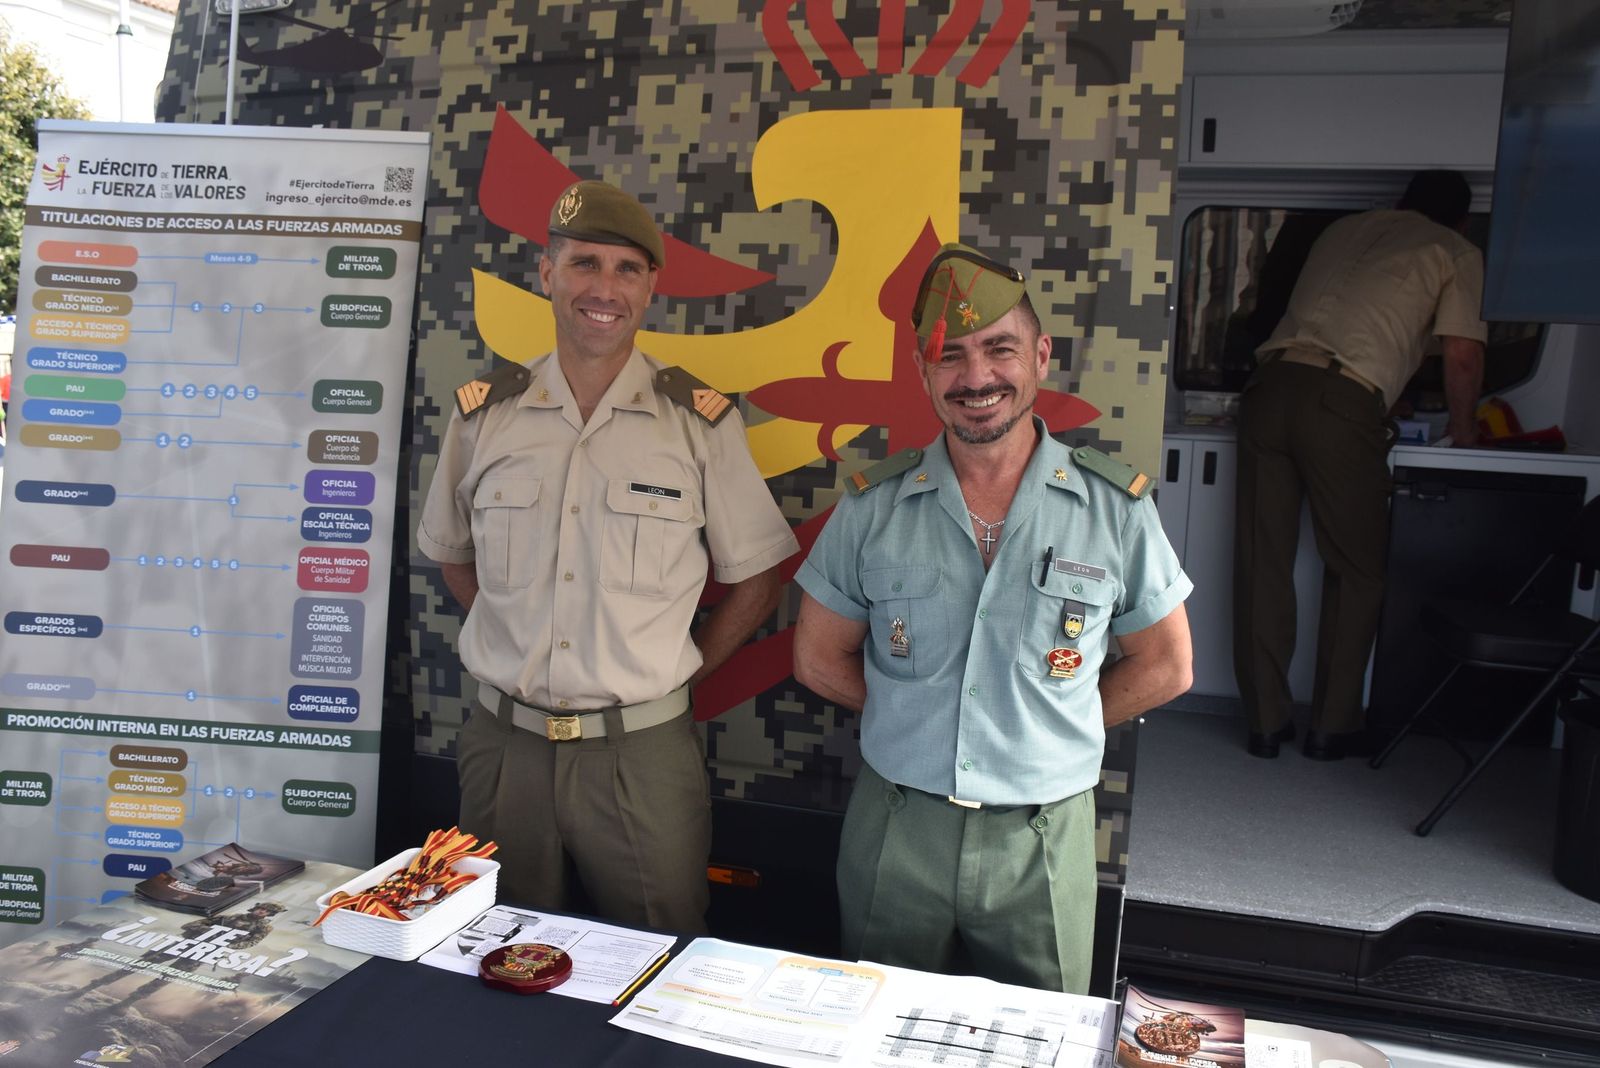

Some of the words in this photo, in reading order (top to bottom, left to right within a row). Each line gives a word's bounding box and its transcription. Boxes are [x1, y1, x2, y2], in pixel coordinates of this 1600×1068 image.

[79, 158, 157, 178] EJÉRCITO
[289, 180, 375, 190] #EjercitodeTierra
[92, 181, 156, 198] FUERZA
[174, 184, 246, 200] VALORES
[265, 192, 412, 207] ingreso_ejercito@mde.es
[41, 211, 143, 228] TITULACIONES
[146, 217, 164, 228] DE
[167, 218, 222, 230] ACCESO
[225, 219, 235, 230] A
[238, 219, 263, 231] LAS
[266, 220, 329, 233] FUERZAS
[331, 223, 403, 235] ARMADAS
[210, 254, 236, 263] Meses
[343, 255, 380, 263] MILITAR
[338, 263, 350, 271] DE
[353, 263, 383, 272] TROPA
[51, 273, 121, 286] BACHILLERATO
[62, 293, 104, 304] TÉCNICO
[45, 301, 79, 311] GRADO
[194, 303, 200, 311] 1
[329, 303, 383, 313] SUBOFICIAL
[330, 312, 353, 321] Cuerpo
[354, 312, 380, 321] General
[36, 320, 74, 328] ACCESO
[75, 321, 83, 329] A
[85, 320, 125, 332] TÉCNICO
[35, 327, 69, 337] GRADO
[56, 351, 98, 361] TÉCNICO
[31, 360, 66, 368] GRADO
[65, 384, 86, 393] PAU
[163, 386, 172, 395] 1
[185, 386, 194, 396] 2
[207, 387, 216, 397] 3
[226, 387, 235, 397] 4
[246, 388, 255, 398] 5
[329, 389, 366, 397] OFICIAL
[322, 397, 346, 406] Cuerpo
[346, 398, 372, 406] General
[159, 436, 166, 445] 1
[180, 437, 189, 447] 2
[325, 435, 361, 444] OFICIAL
[326, 444, 350, 452] Cuerpo
[323, 453, 361, 461] Intendencia
[322, 479, 358, 488] OFICIAL
[322, 488, 356, 498] Ingenieros
[647, 487, 665, 495] LEON
[230, 497, 237, 505] 1
[319, 512, 355, 520] OFICIAL
[303, 520, 334, 529] ESCALA
[335, 521, 370, 531] TÉCNICA
[318, 530, 352, 540] Ingenieros
[51, 554, 71, 562] PAU
[139, 557, 146, 565] 1
[157, 557, 164, 565] 2
[175, 558, 183, 566] 3
[193, 559, 202, 567] 4
[212, 560, 219, 568] 5
[230, 561, 238, 569] 6
[300, 556, 332, 565] OFICIAL
[334, 556, 368, 567] MÉDICO
[310, 566, 334, 575] Cuerpo
[335, 566, 356, 575] Militar
[314, 575, 323, 583] de
[324, 575, 351, 584] Sanidad
[312, 605, 345, 614] OFICIAL
[34, 616, 75, 626] GRADOS
[308, 613, 349, 623] CUERPOS
[192, 627, 199, 635] 1
[312, 634, 342, 643] SANIDAD
[310, 644, 343, 653] JURÍDICO
[301, 654, 351, 664] INTERVENCIÓN
[298, 663, 324, 673] MÚSICA
[325, 665, 352, 675] MILITAR
[188, 692, 194, 700] 1
[300, 695, 334, 704] OFICIAL
[335, 697, 348, 705] DE
[289, 703, 358, 715] COMPLEMENTO
[7, 714, 94, 731] PROMOCIÓN
[97, 719, 157, 735] INTERNA
[160, 725, 179, 737] EN
[181, 725, 208, 739] LAS
[210, 727, 275, 743] FUERZAS
[278, 731, 352, 747] ARMADAS
[118, 753, 179, 764] BACHILLERATO
[6, 779, 43, 789] MILITAR
[128, 774, 165, 784] TÉCNICO
[114, 783, 144, 792] GRADO
[206, 787, 213, 795] 1
[226, 788, 233, 797] 2
[246, 789, 254, 798] 3
[1, 788, 14, 797] DE
[15, 789, 47, 799] TROPA
[284, 788, 353, 800] SUBOFICIAL
[110, 802, 140, 810] ACCESO
[140, 803, 147, 811] A
[148, 804, 181, 813] TÉCNICO
[287, 797, 317, 809] Cuerpo
[318, 799, 350, 809] General
[109, 810, 137, 818] GRADO
[127, 830, 161, 840] TÉCNICO
[107, 837, 136, 846] GRADO
[128, 863, 147, 872] PAU
[2, 873, 34, 883] MILITAR
[0, 882, 10, 890] DE
[10, 882, 38, 892] TROPA
[0, 900, 42, 910] UBOFICIAL
[16, 909, 41, 919] General
[196, 924, 250, 947] TE
[101, 916, 309, 977] ¿INTERESA?
